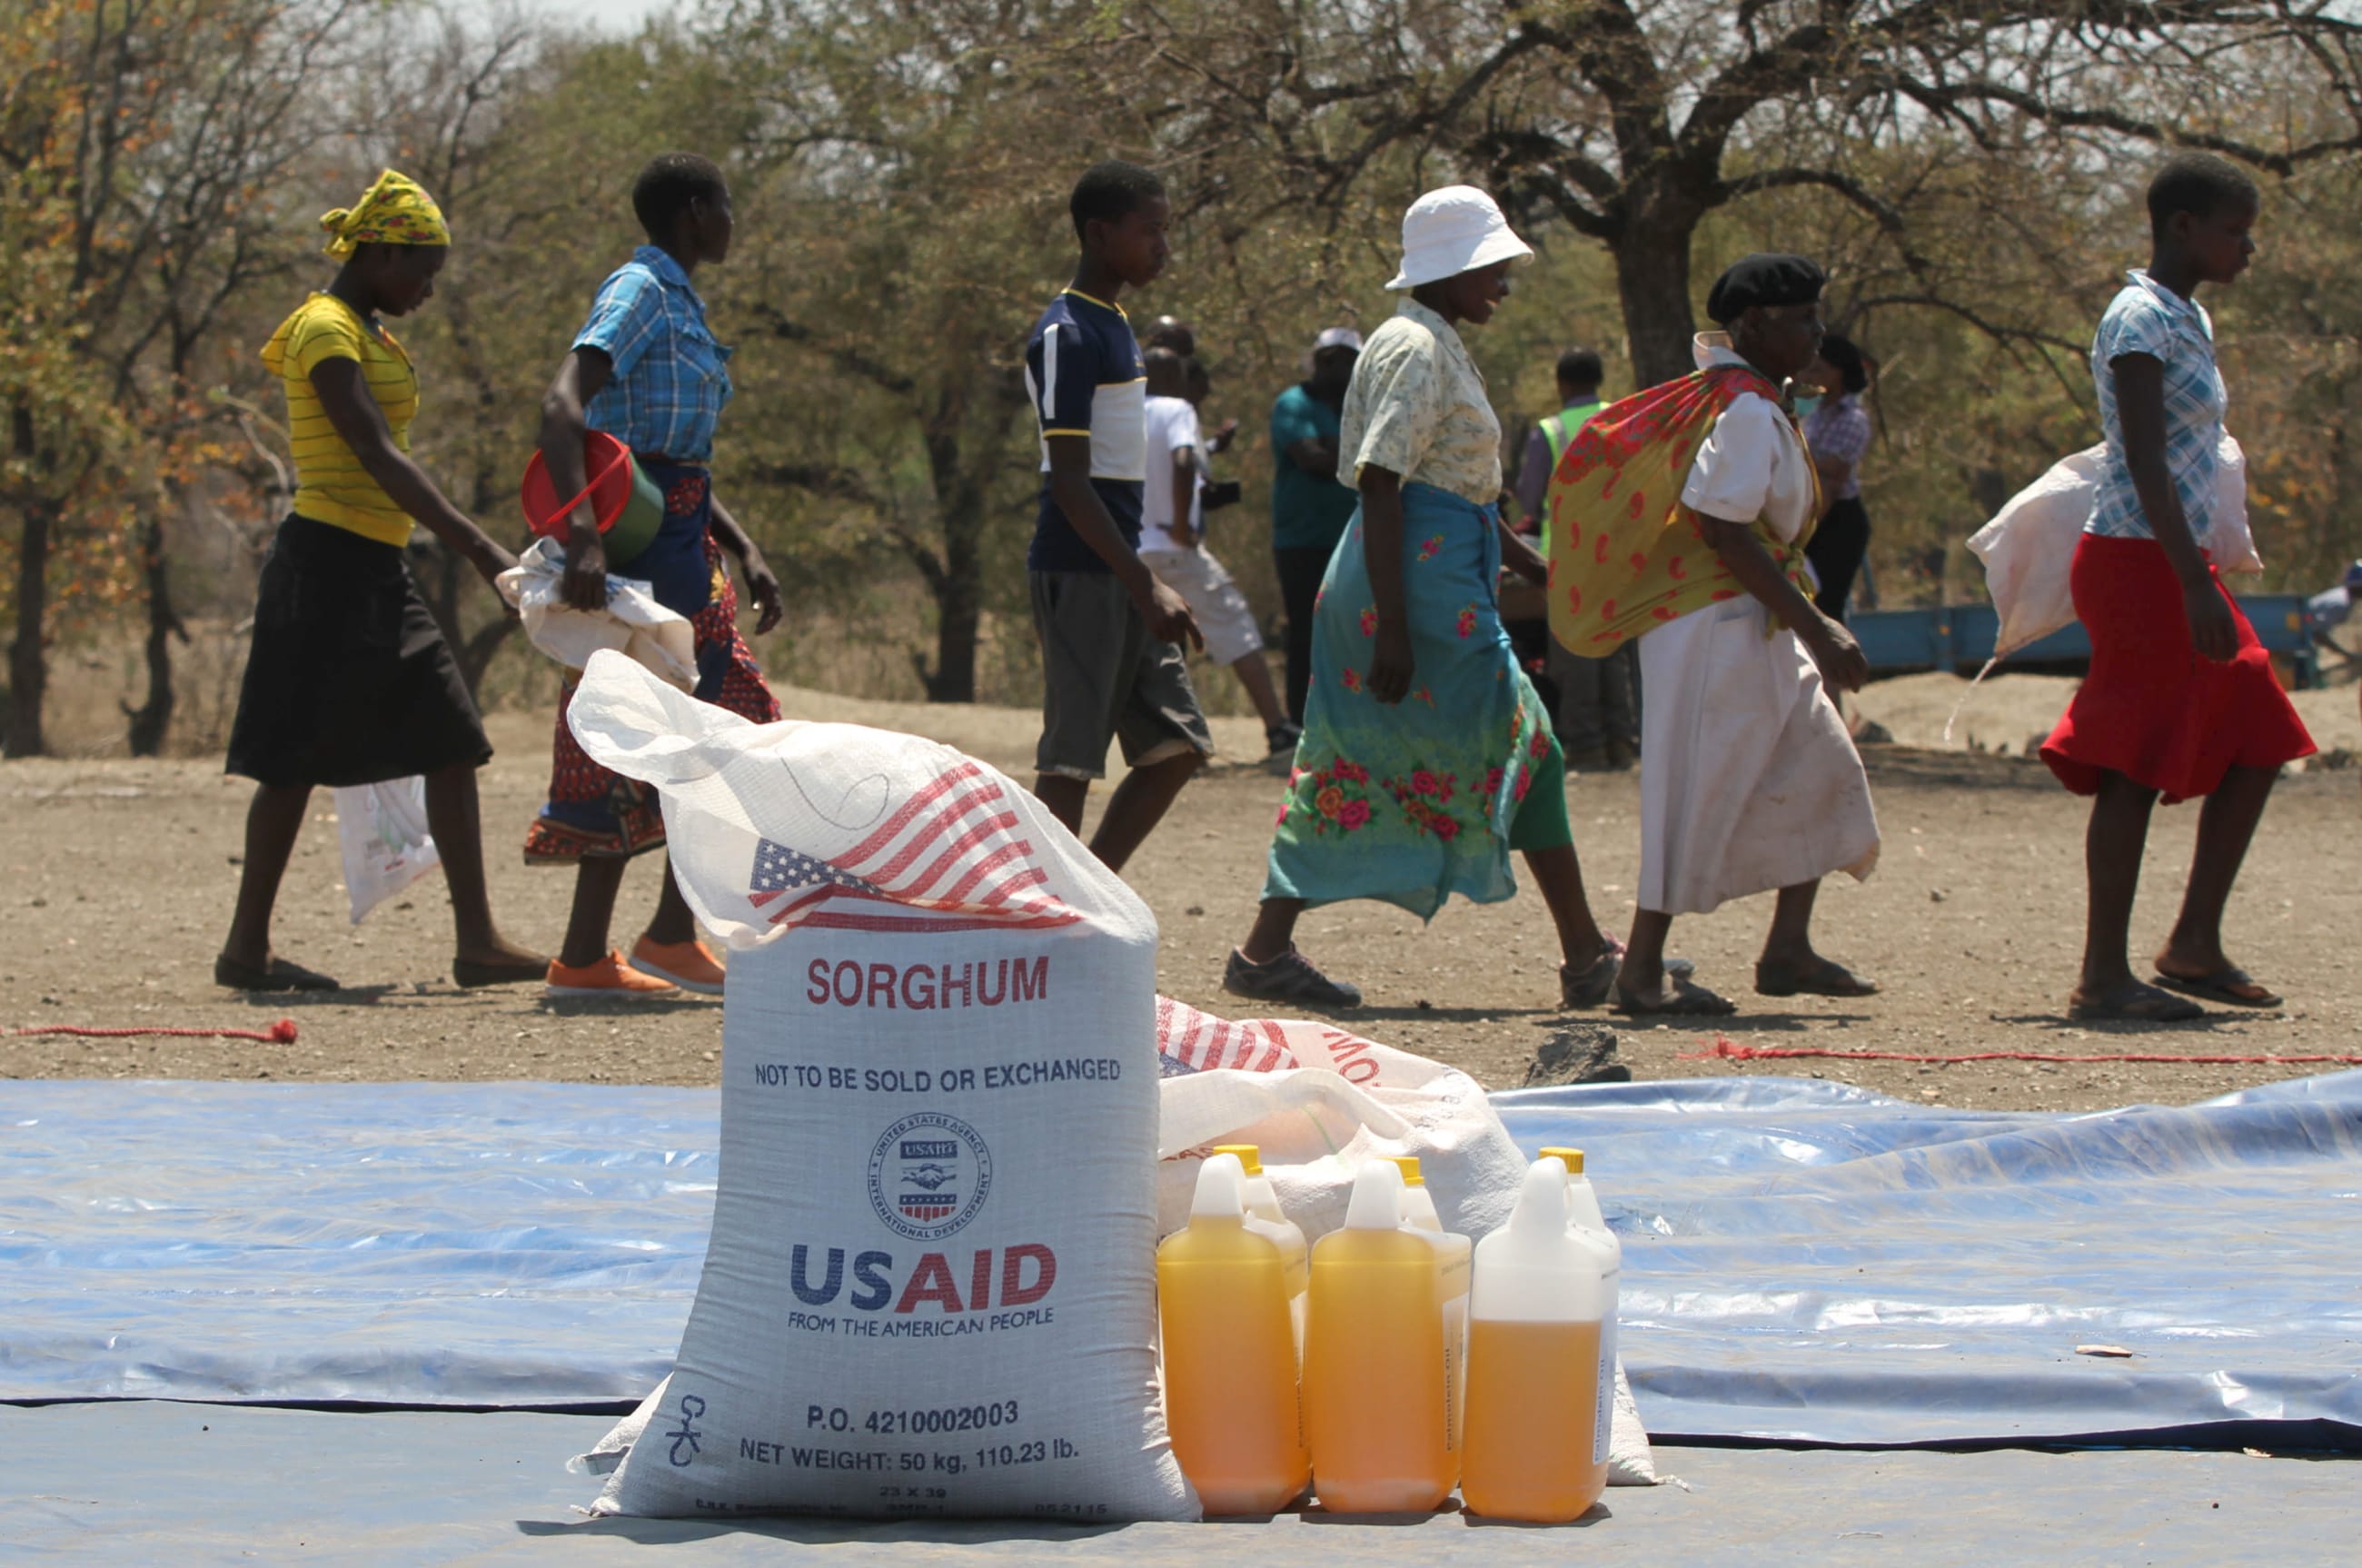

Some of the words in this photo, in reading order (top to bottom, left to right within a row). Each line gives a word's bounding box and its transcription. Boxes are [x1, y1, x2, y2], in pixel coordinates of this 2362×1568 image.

[807, 956, 1048, 1009] SORGHUM
[755, 1064, 789, 1087] NOT
[794, 1065, 820, 1088] TO
[829, 1067, 858, 1090] BE
[864, 1068, 931, 1092] SOLD
[939, 1068, 975, 1092] OR
[984, 1058, 1121, 1088] EXCHANGED
[875, 1122, 907, 1156] UNITED
[908, 1115, 948, 1127] STATES
[950, 1121, 986, 1156] AGENCY
[868, 1174, 931, 1239] INTERNATIONAL
[934, 1172, 990, 1238] DEVELOPMENT
[789, 1243, 1057, 1315] USAID
[787, 1311, 837, 1334] FROM
[842, 1318, 878, 1338] THE
[881, 1317, 984, 1339] AMERICAN
[989, 1306, 1055, 1332] PEOPLE
[807, 1404, 856, 1433] P.O.
[865, 1400, 1019, 1434] 4210002003
[739, 1437, 785, 1467] NET
[791, 1445, 892, 1472] WEIGHT:
[898, 1453, 926, 1472] 50
[933, 1451, 968, 1475] kg,
[977, 1441, 1046, 1468] 110.23
[1052, 1437, 1079, 1461] lb.
[879, 1486, 901, 1497] 23
